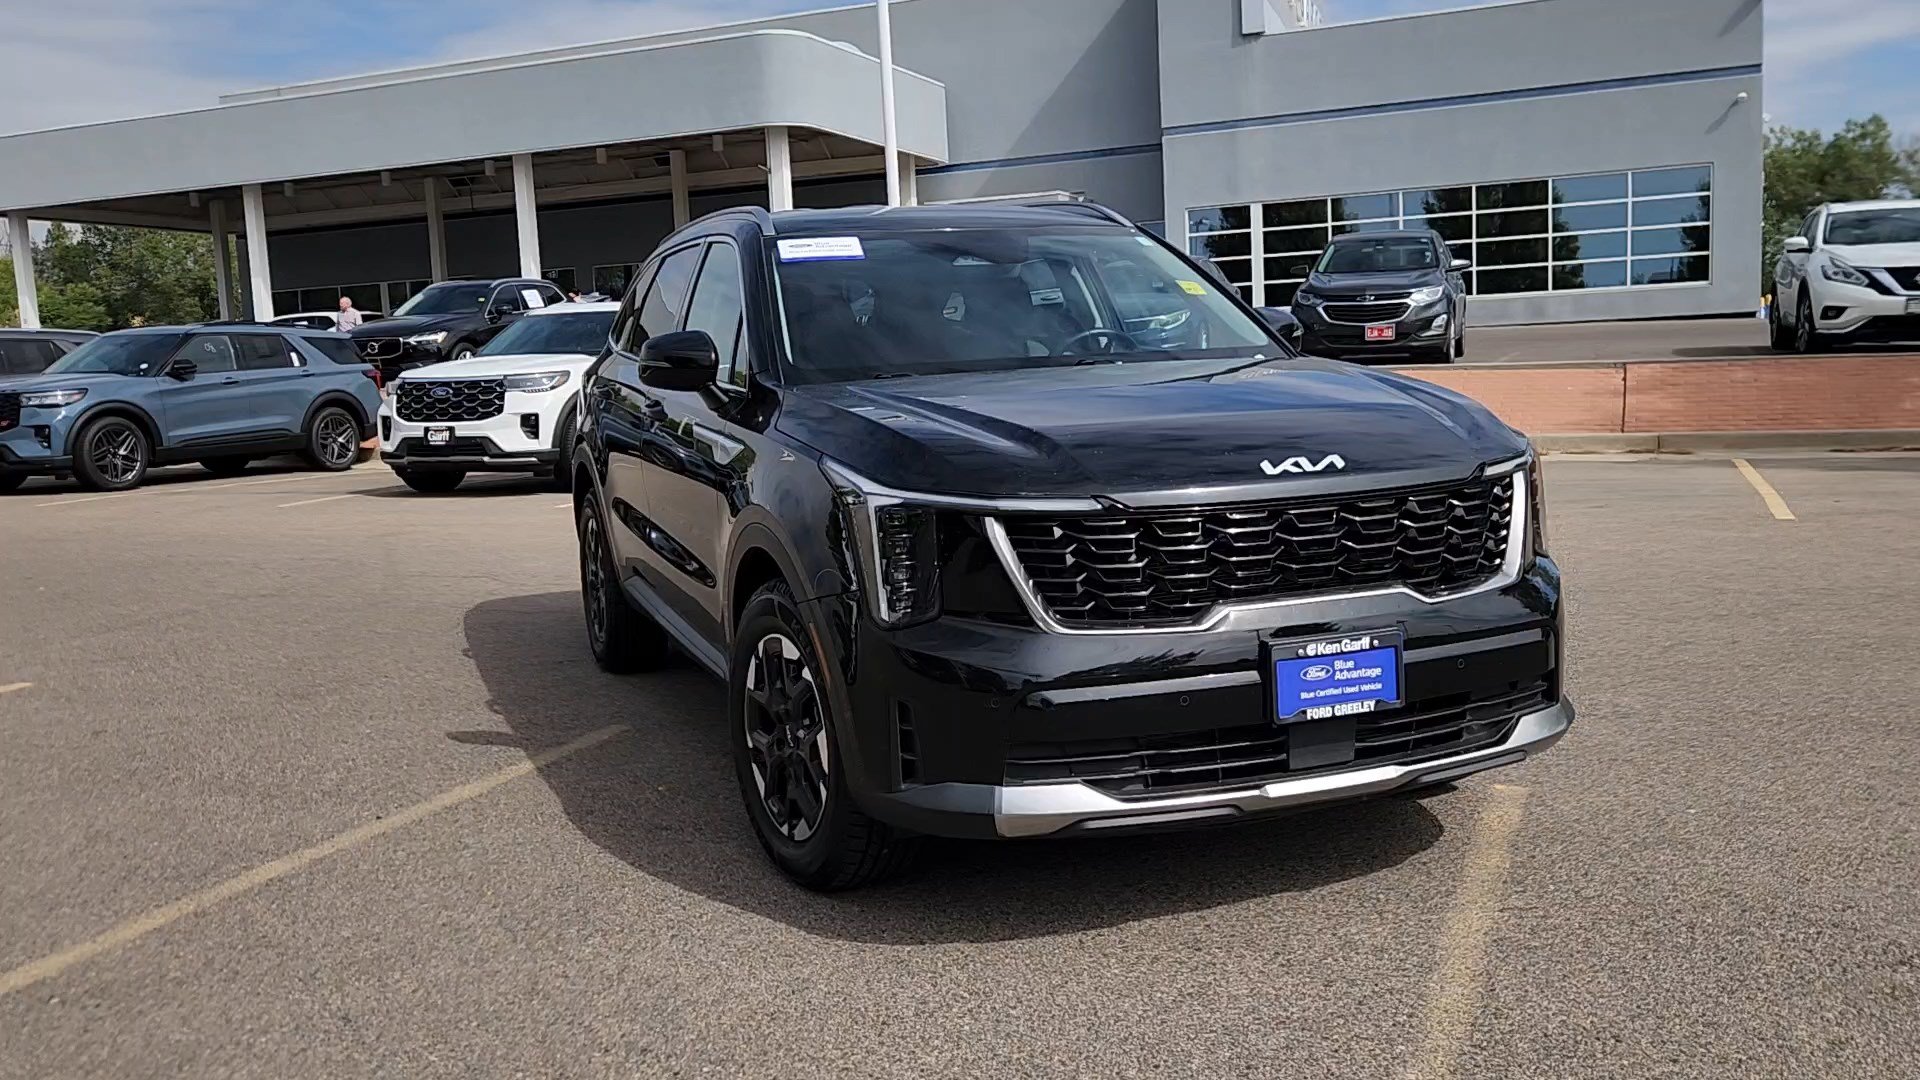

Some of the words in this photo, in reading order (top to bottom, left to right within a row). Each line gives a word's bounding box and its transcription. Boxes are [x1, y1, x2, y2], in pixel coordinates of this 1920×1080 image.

[1317, 642, 1341, 656] Ken
[1341, 636, 1371, 651] Garff
[1333, 660, 1355, 671] Blue
[1334, 666, 1382, 681] Advantage
[1300, 691, 1315, 700] Blue
[1315, 686, 1342, 699] Certified
[1343, 685, 1359, 694] Used
[1360, 682, 1383, 692] Vehicle
[1306, 706, 1333, 720] FORD
[1334, 700, 1376, 717] GREELEY
